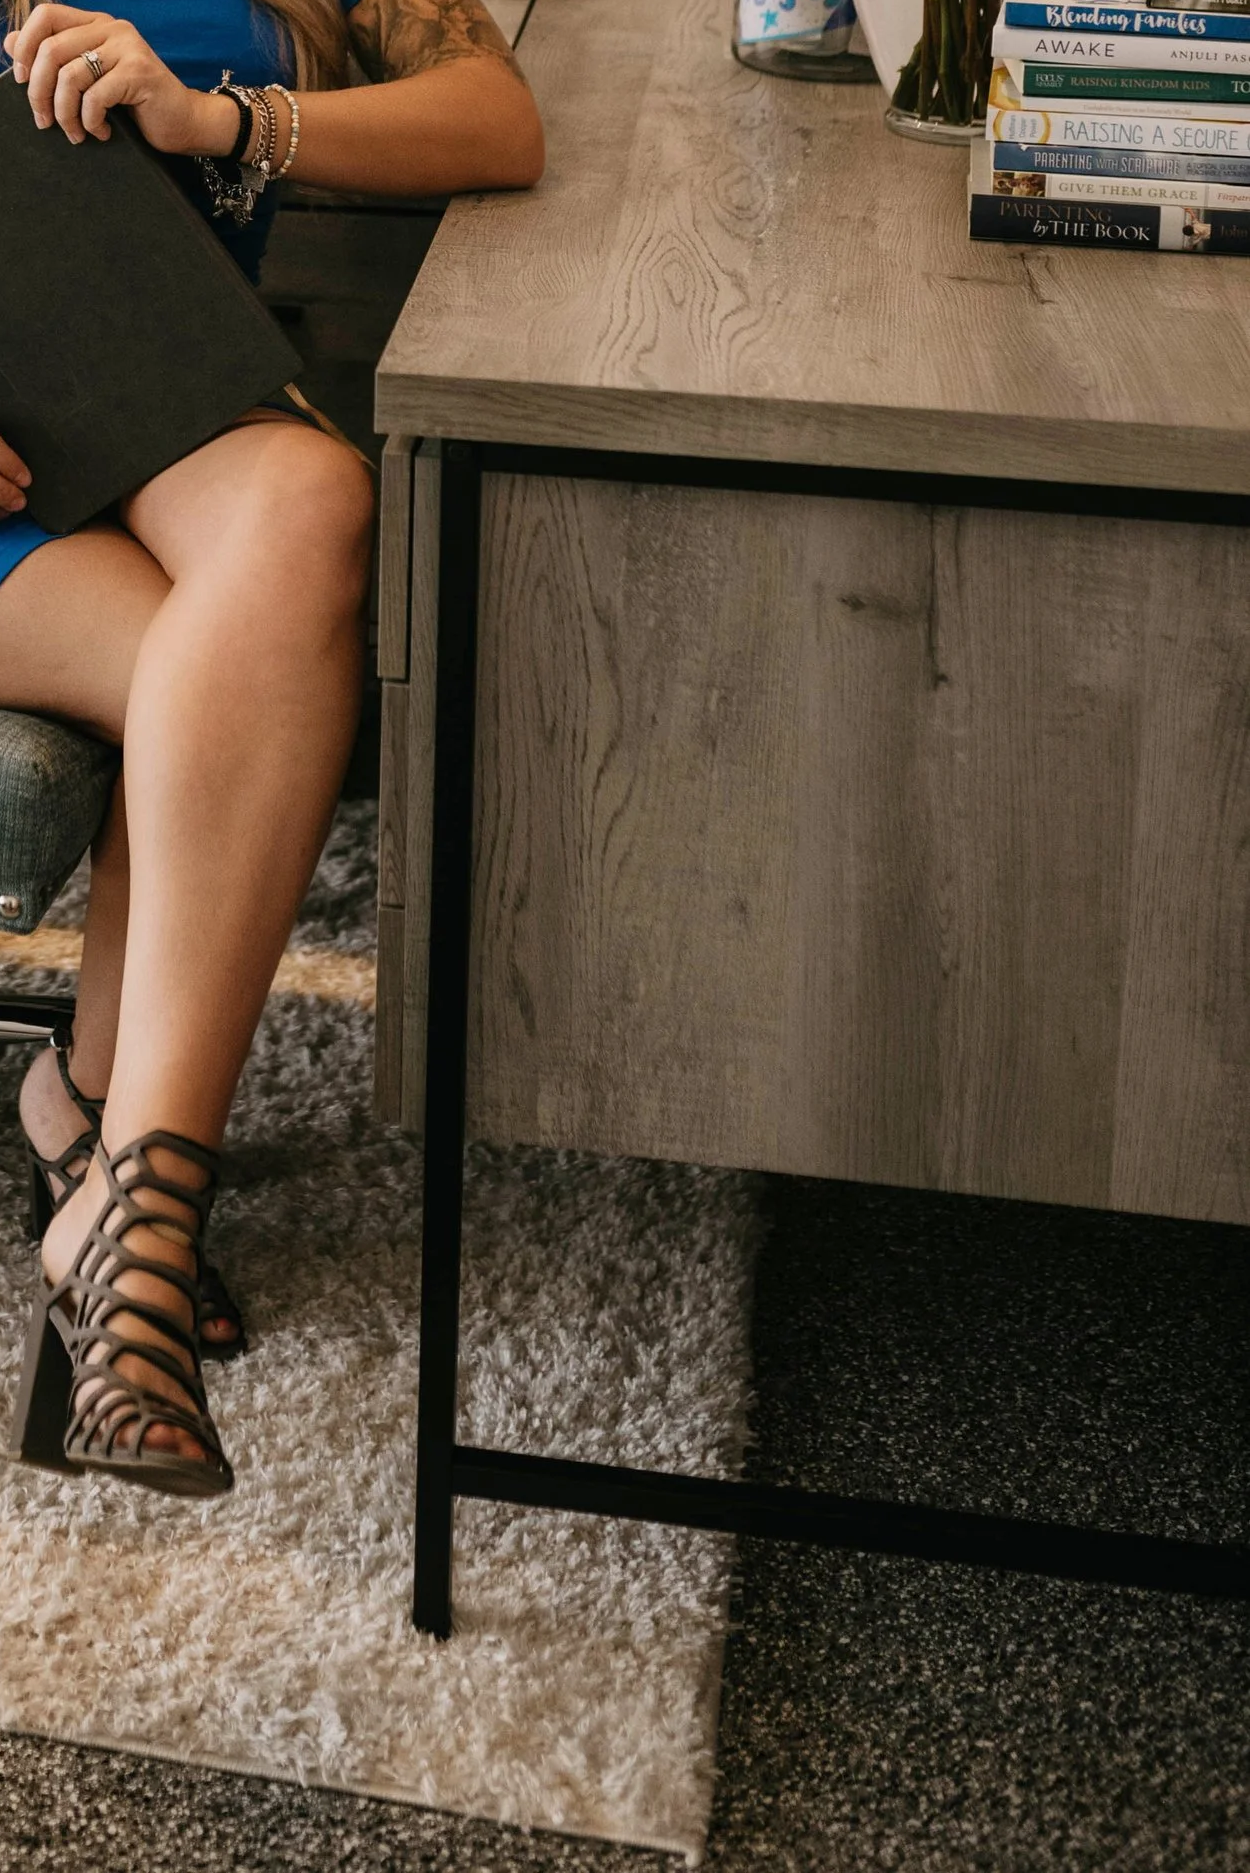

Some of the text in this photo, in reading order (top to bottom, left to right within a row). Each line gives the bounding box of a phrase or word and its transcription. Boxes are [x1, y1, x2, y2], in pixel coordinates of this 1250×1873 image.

[1046, 6, 1207, 35] Blending Families
[1035, 39, 1250, 63] AWAKE ANJULI PAS
[1071, 77, 1117, 87] RAISING
[1120, 78, 1179, 89] KINGDOM
[1182, 81, 1210, 90] KIDS
[1064, 120, 1143, 145] RAISING
[1152, 125, 1165, 145] A
[1172, 127, 1239, 150] SECURE
[1034, 152, 1093, 171] PARENTING
[1121, 157, 1179, 176] SCRIPTURE
[1059, 182, 1094, 193] GIVE
[1100, 185, 1142, 197] THEM
[1148, 188, 1198, 200] GRACE
[1000, 201, 1112, 223] PARENTING
[1033, 220, 1048, 237] by
[1049, 220, 1090, 238] THE
[1095, 223, 1151, 241] BOOK
